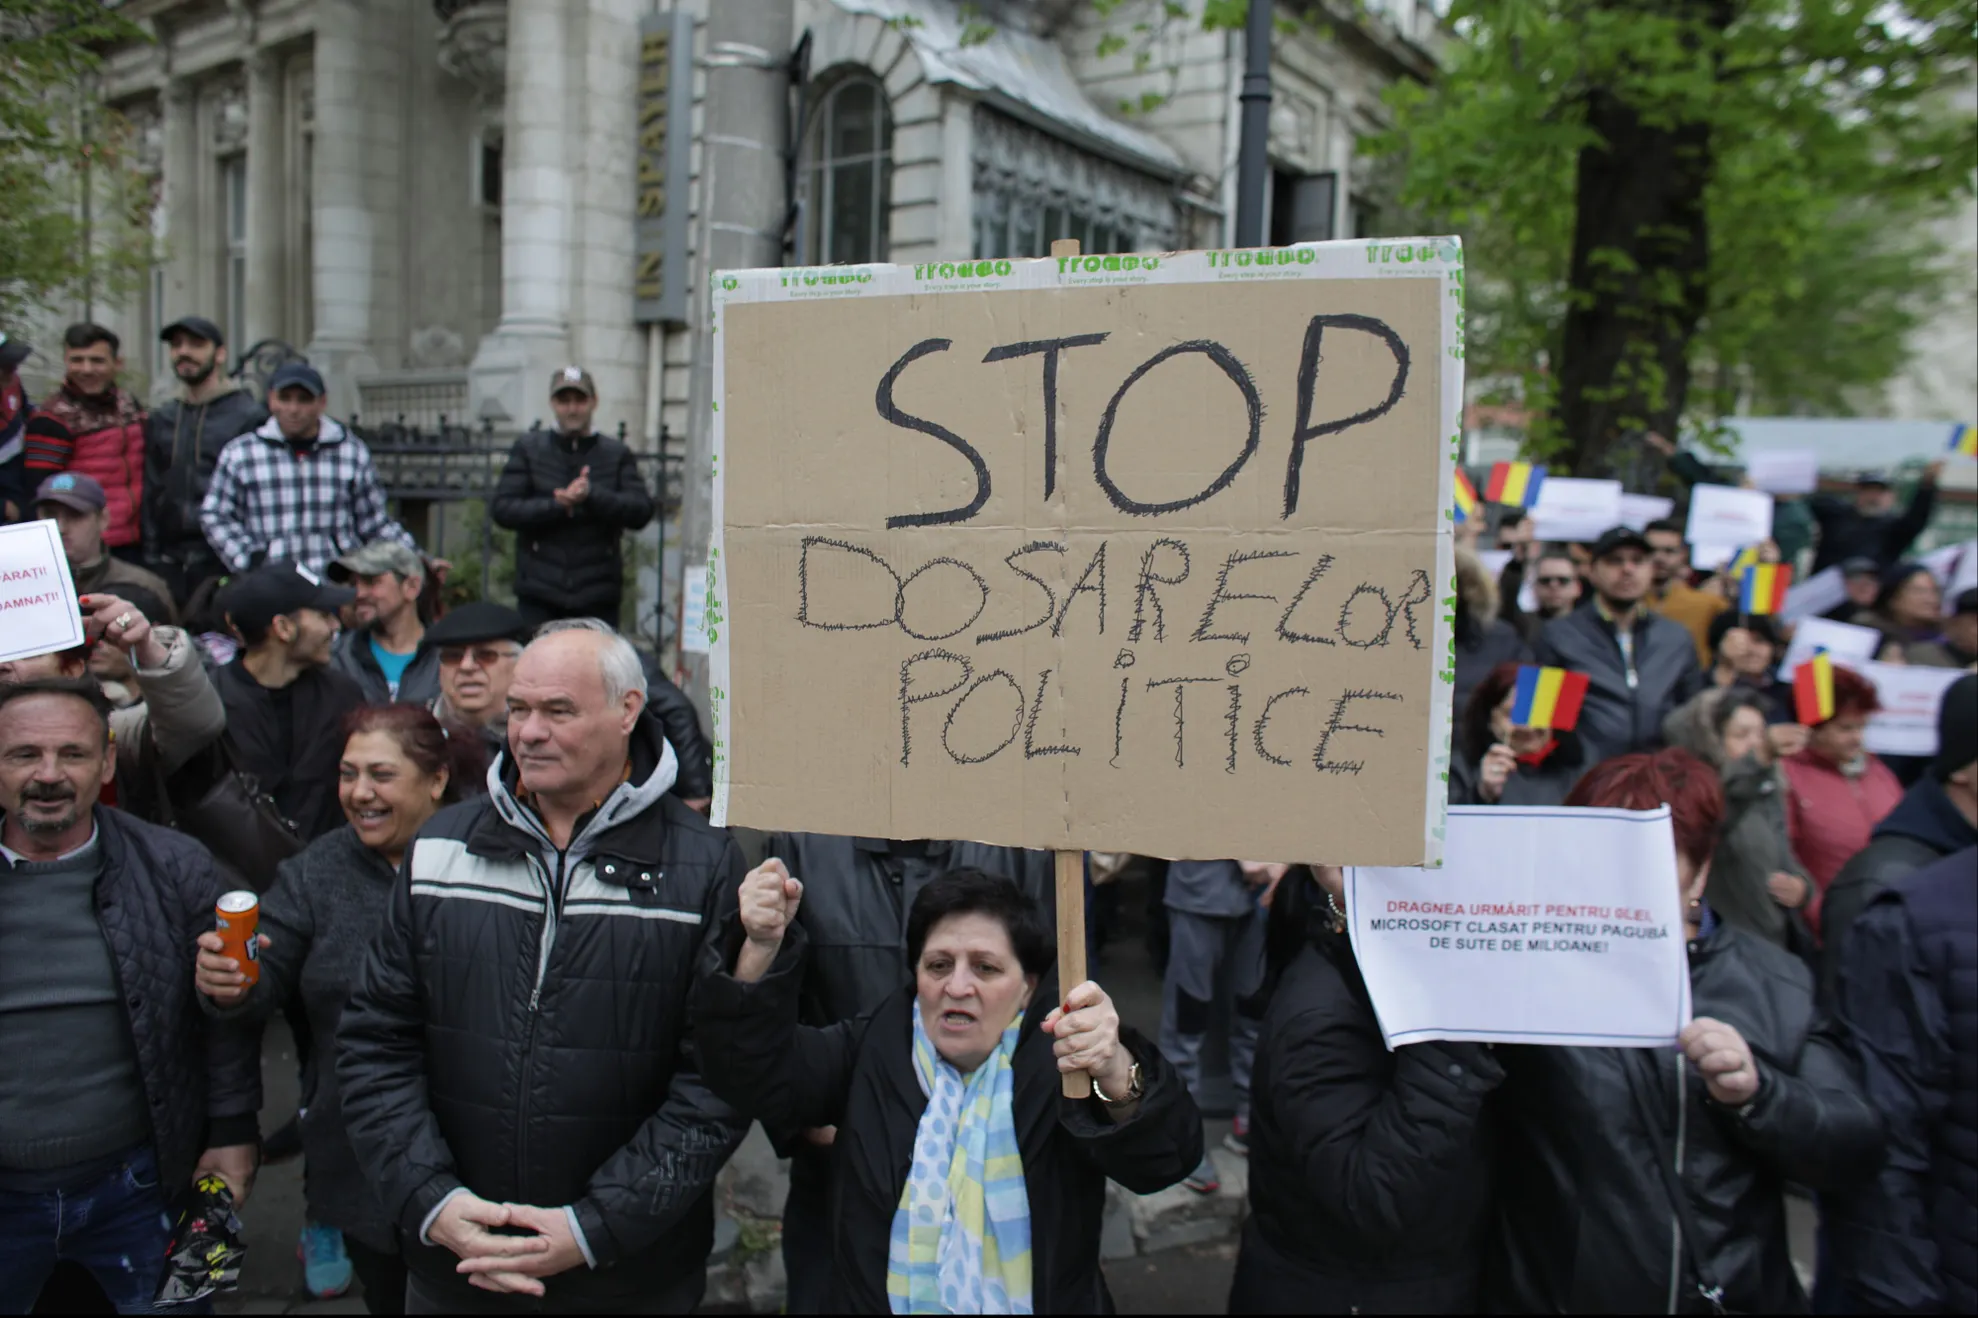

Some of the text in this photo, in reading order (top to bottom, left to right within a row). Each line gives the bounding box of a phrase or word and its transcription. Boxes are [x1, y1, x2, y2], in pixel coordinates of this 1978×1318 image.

[875, 314, 1410, 530] STOP
[796, 536, 1432, 650] DOSARELOR
[1387, 901, 1464, 915] DRAGNEA
[1546, 904, 1609, 919] PENTRU
[1370, 918, 1462, 931] MICROSOFT
[1466, 921, 1528, 934] CLASAT
[1532, 922, 1597, 936] PENTRU
[1429, 937, 1451, 949] DE
[1456, 938, 1496, 951] SUTE
[1501, 939, 1523, 951] DE
